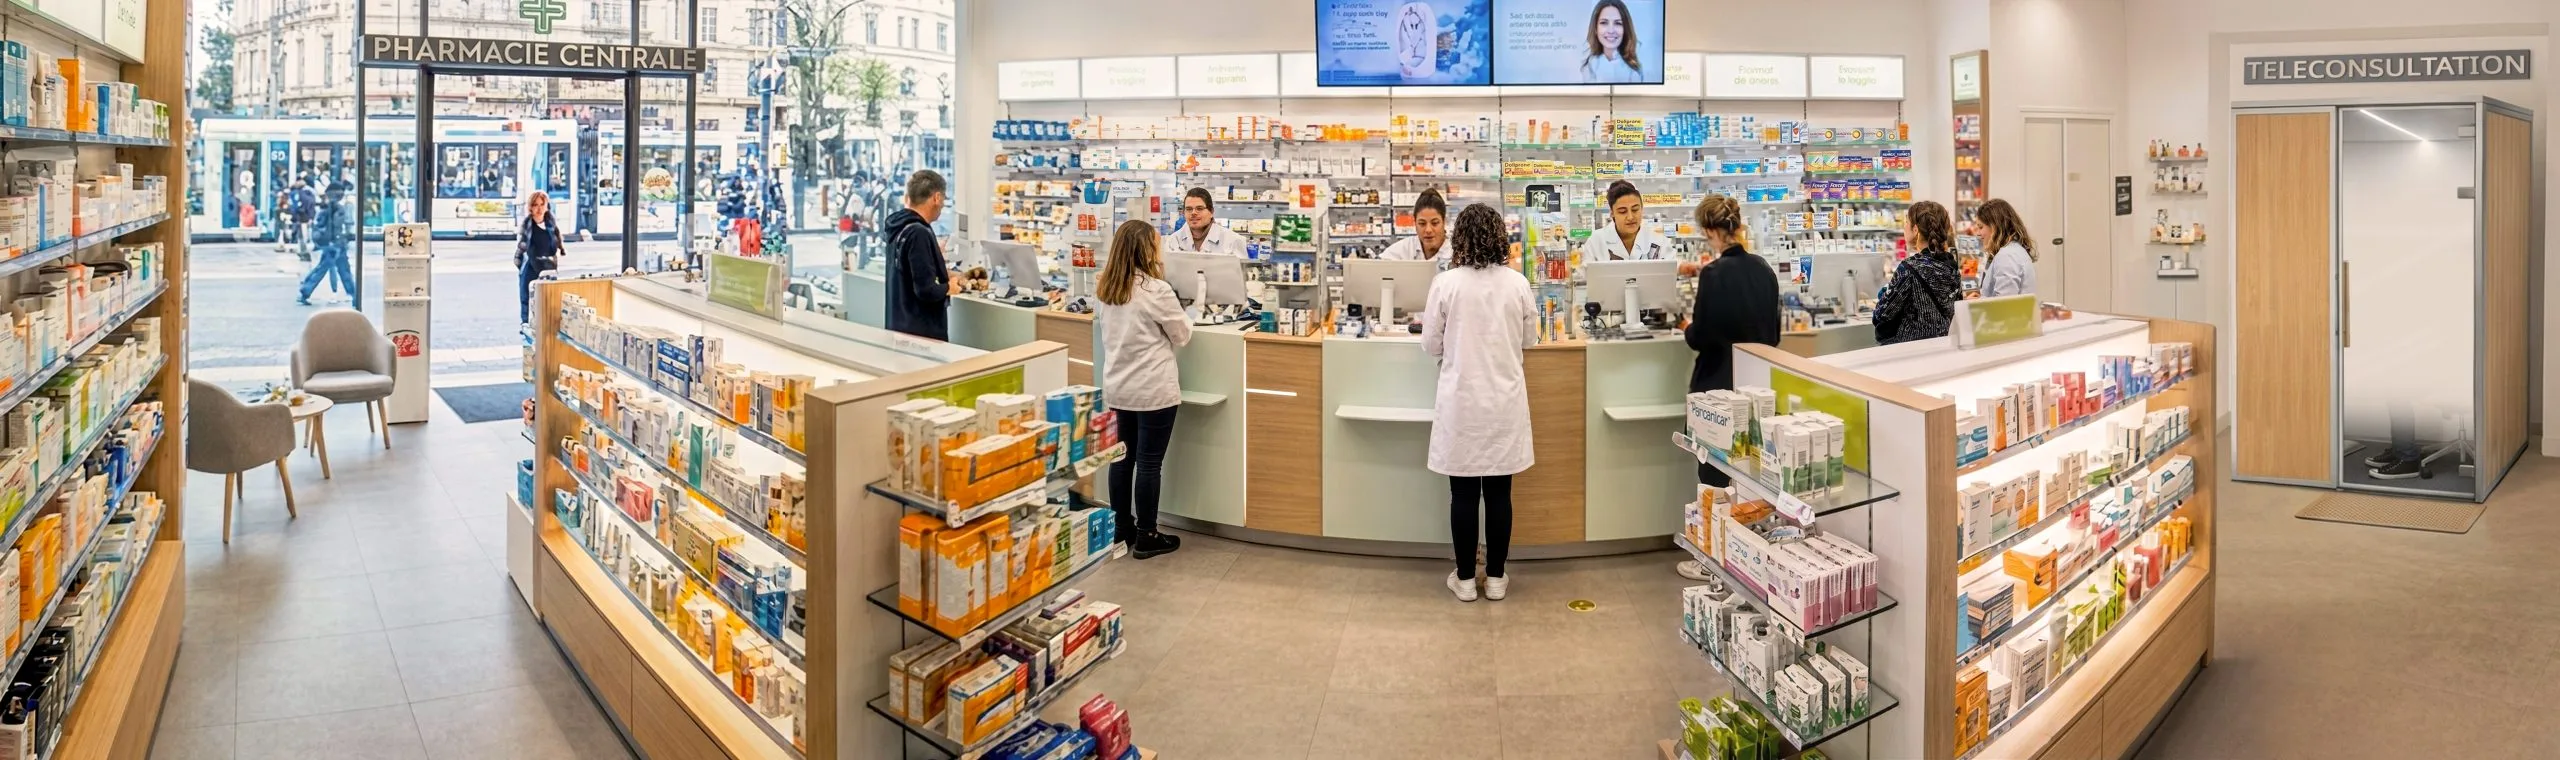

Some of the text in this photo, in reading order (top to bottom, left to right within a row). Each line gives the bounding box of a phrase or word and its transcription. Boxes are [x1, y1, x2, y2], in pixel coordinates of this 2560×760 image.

[373, 37, 697, 71] PHARMACIE CENTRALE
[2247, 54, 2525, 81] TELECONSULTATION
